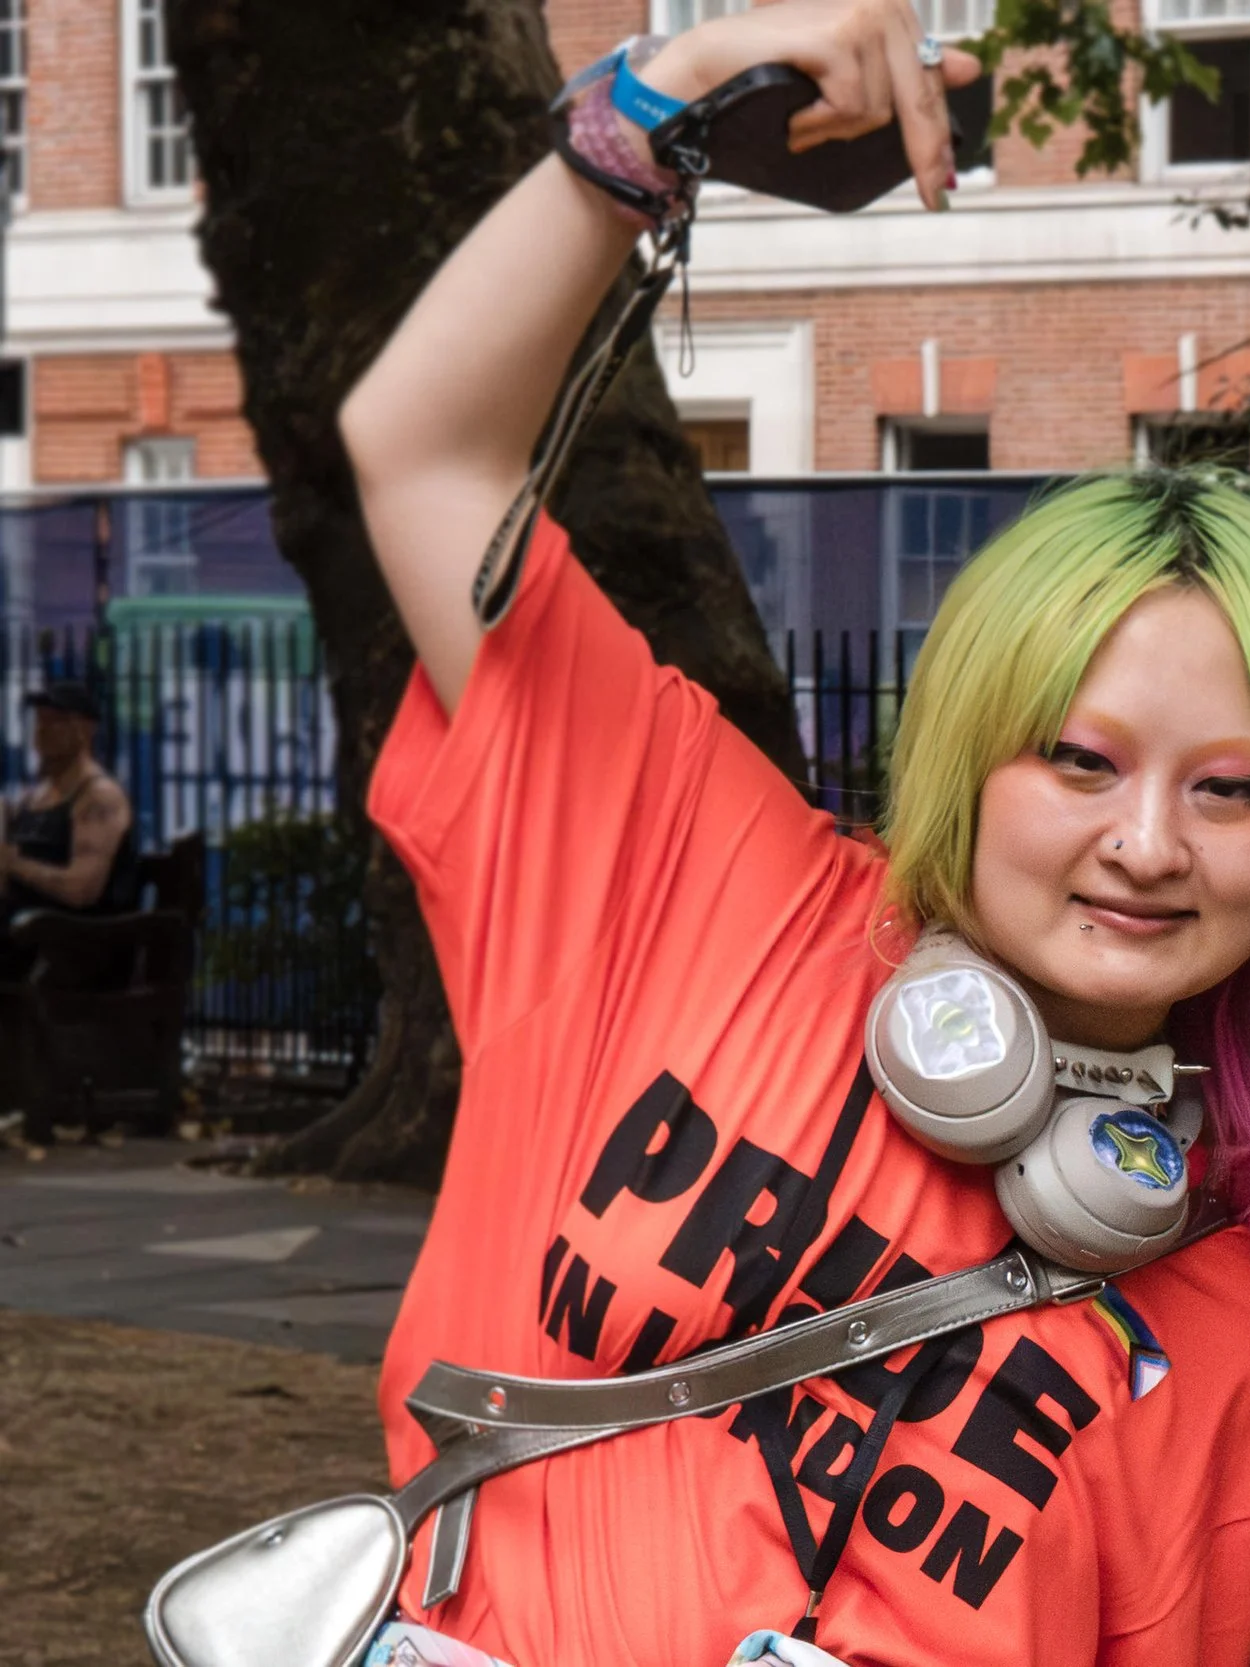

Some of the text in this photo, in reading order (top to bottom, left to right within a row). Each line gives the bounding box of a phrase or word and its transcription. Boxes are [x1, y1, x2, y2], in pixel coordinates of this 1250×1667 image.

[539, 1233, 1023, 1610] IN LNDON
[580, 1069, 1100, 1512] PRIDE
